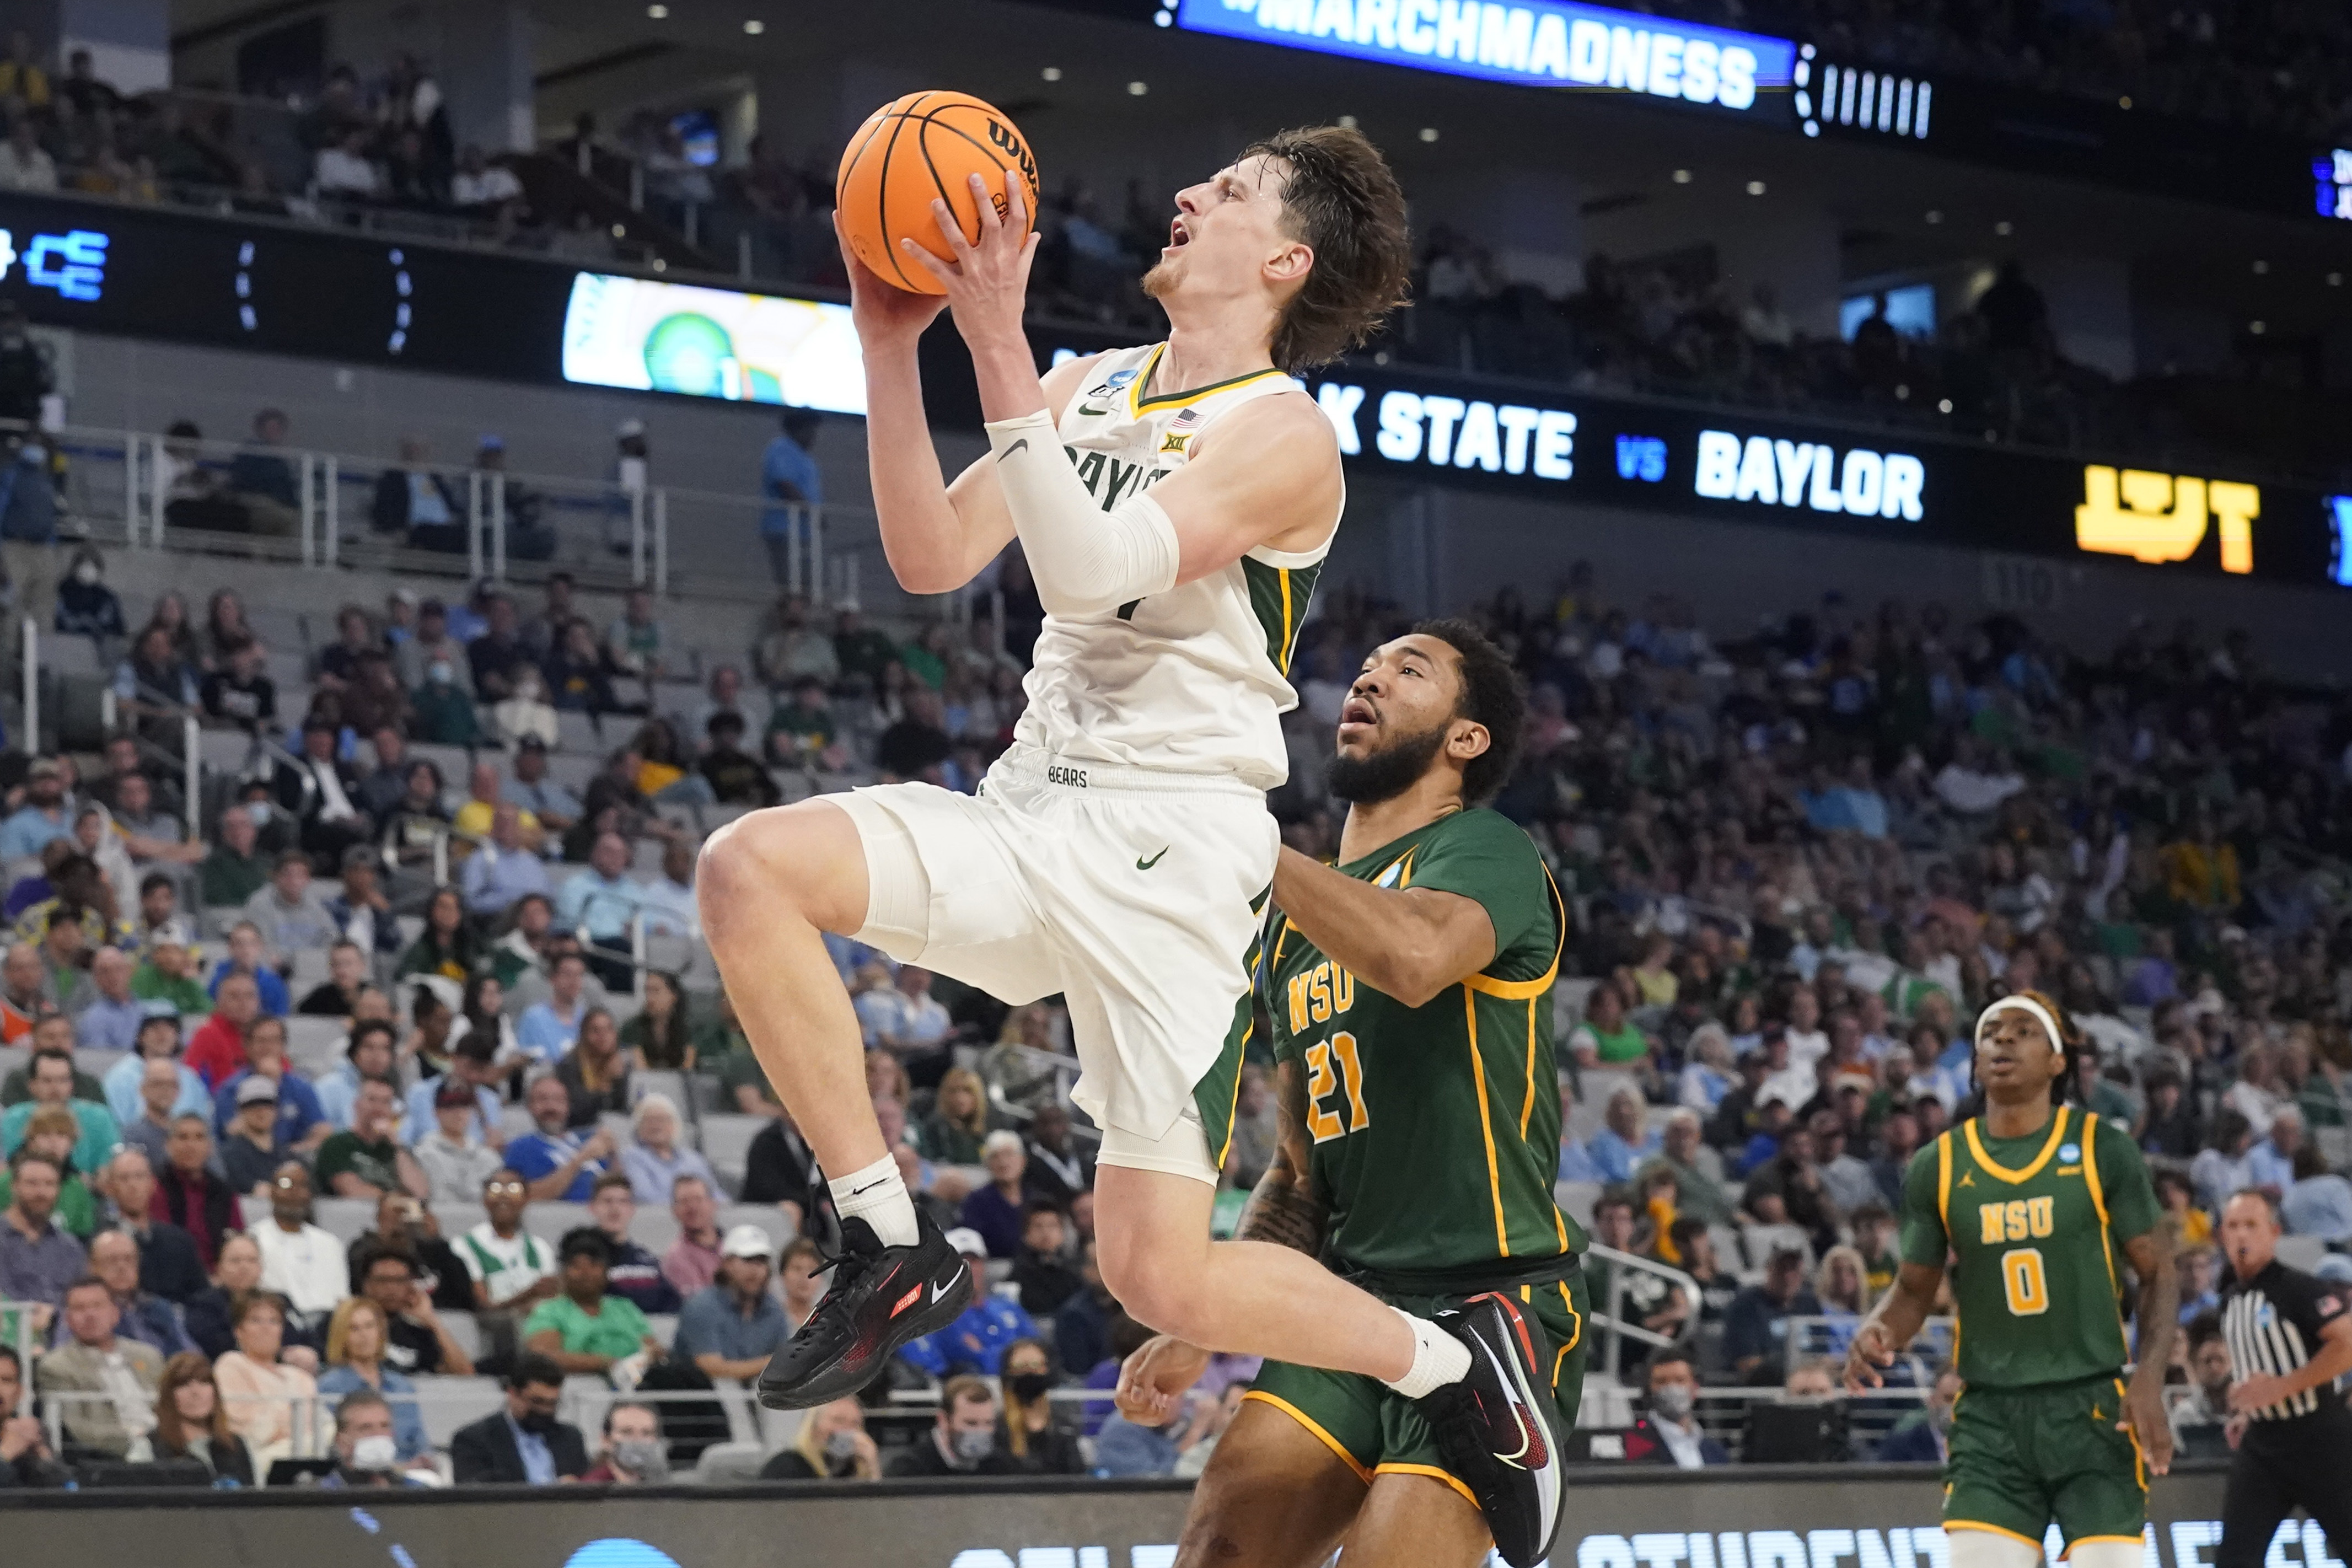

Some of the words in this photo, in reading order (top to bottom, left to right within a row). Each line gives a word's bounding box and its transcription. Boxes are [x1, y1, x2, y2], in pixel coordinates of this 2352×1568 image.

[1222, 0, 1758, 110] MARCHMADNESS
[1376, 390, 1577, 481] STATE
[1615, 434, 1668, 482] VS
[1695, 430, 1925, 521] BAYLOR
[1048, 765, 1087, 788] BEARS
[1287, 959, 1354, 1037] NSU
[1305, 1030, 1370, 1145] 21
[1980, 1196, 2054, 1244] NSU
[2001, 1248, 2049, 1317] 0
